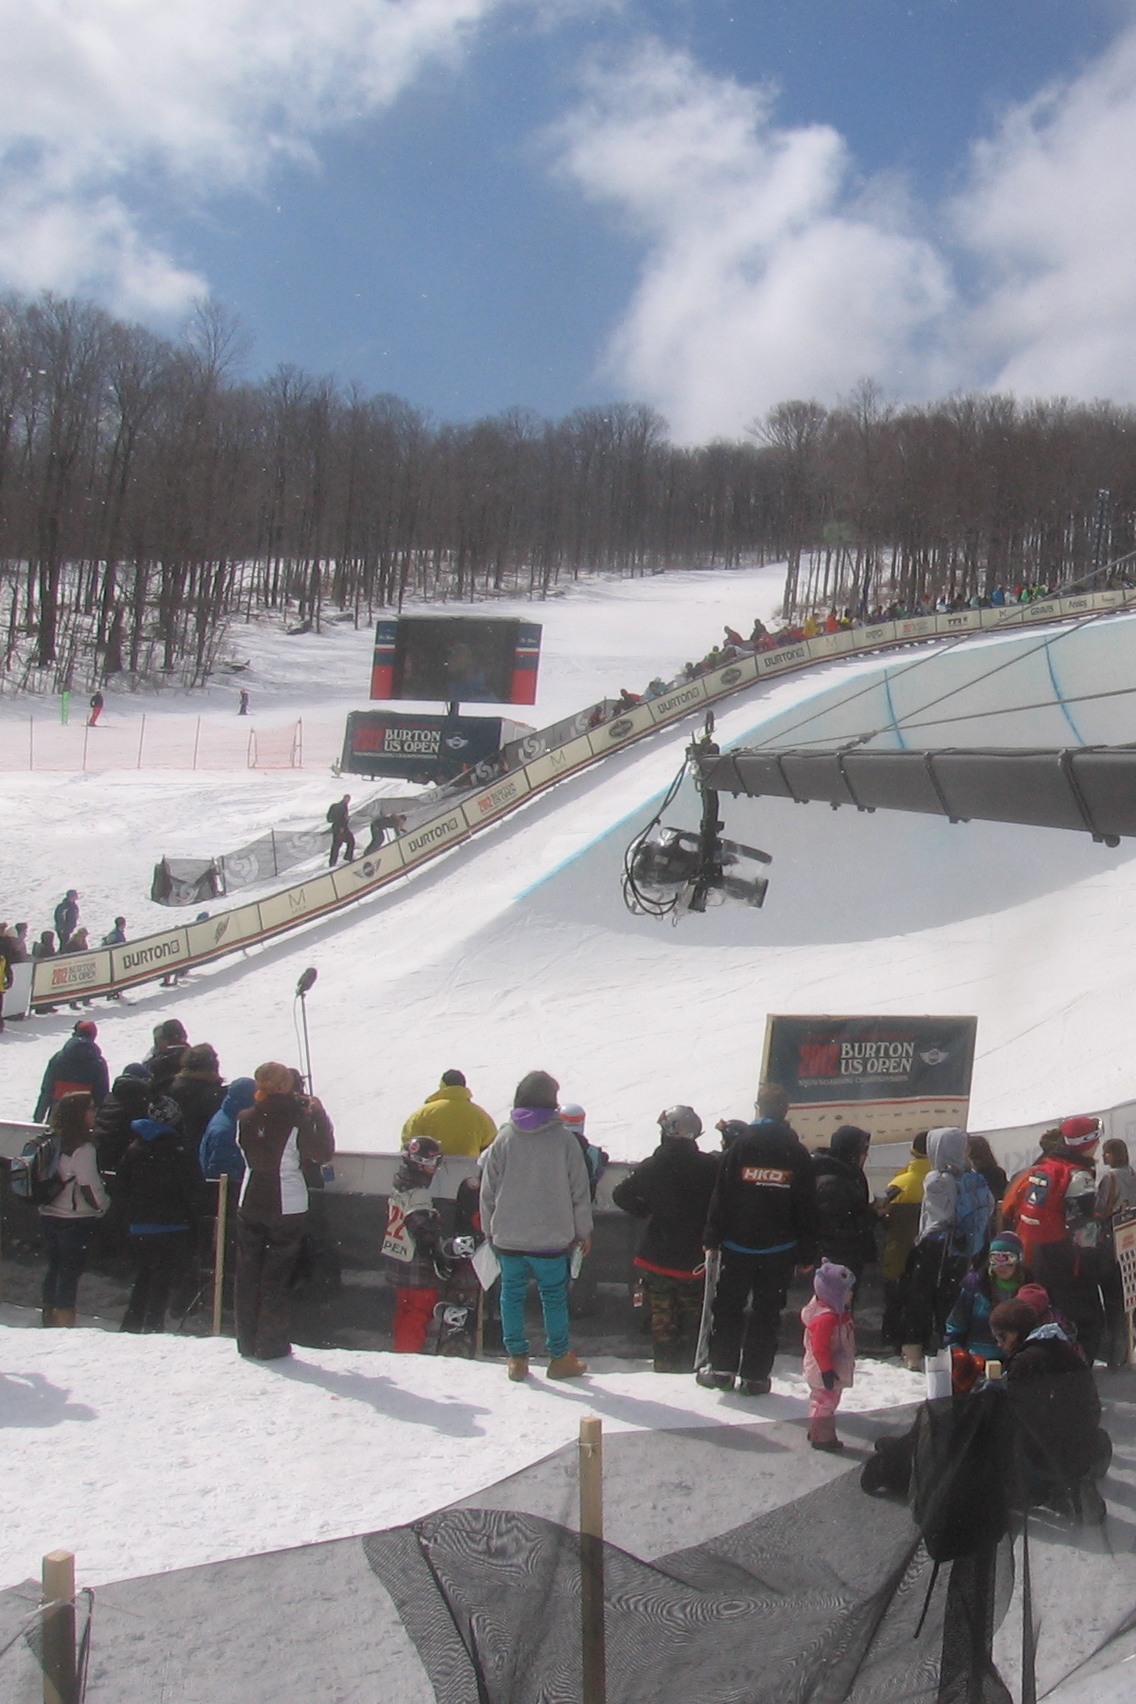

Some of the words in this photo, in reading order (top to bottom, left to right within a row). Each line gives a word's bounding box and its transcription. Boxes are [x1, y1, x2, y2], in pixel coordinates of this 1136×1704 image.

[384, 728, 442, 742] BURTON
[384, 742, 401, 752] US
[404, 742, 440, 753] OPEN
[408, 822, 451, 853] BURTON
[122, 942, 172, 970] BURTON
[841, 1041, 915, 1058] BURTON
[841, 1058, 864, 1075] US
[867, 1057, 913, 1074] OPEN
[382, 1240, 408, 1256] PEN
